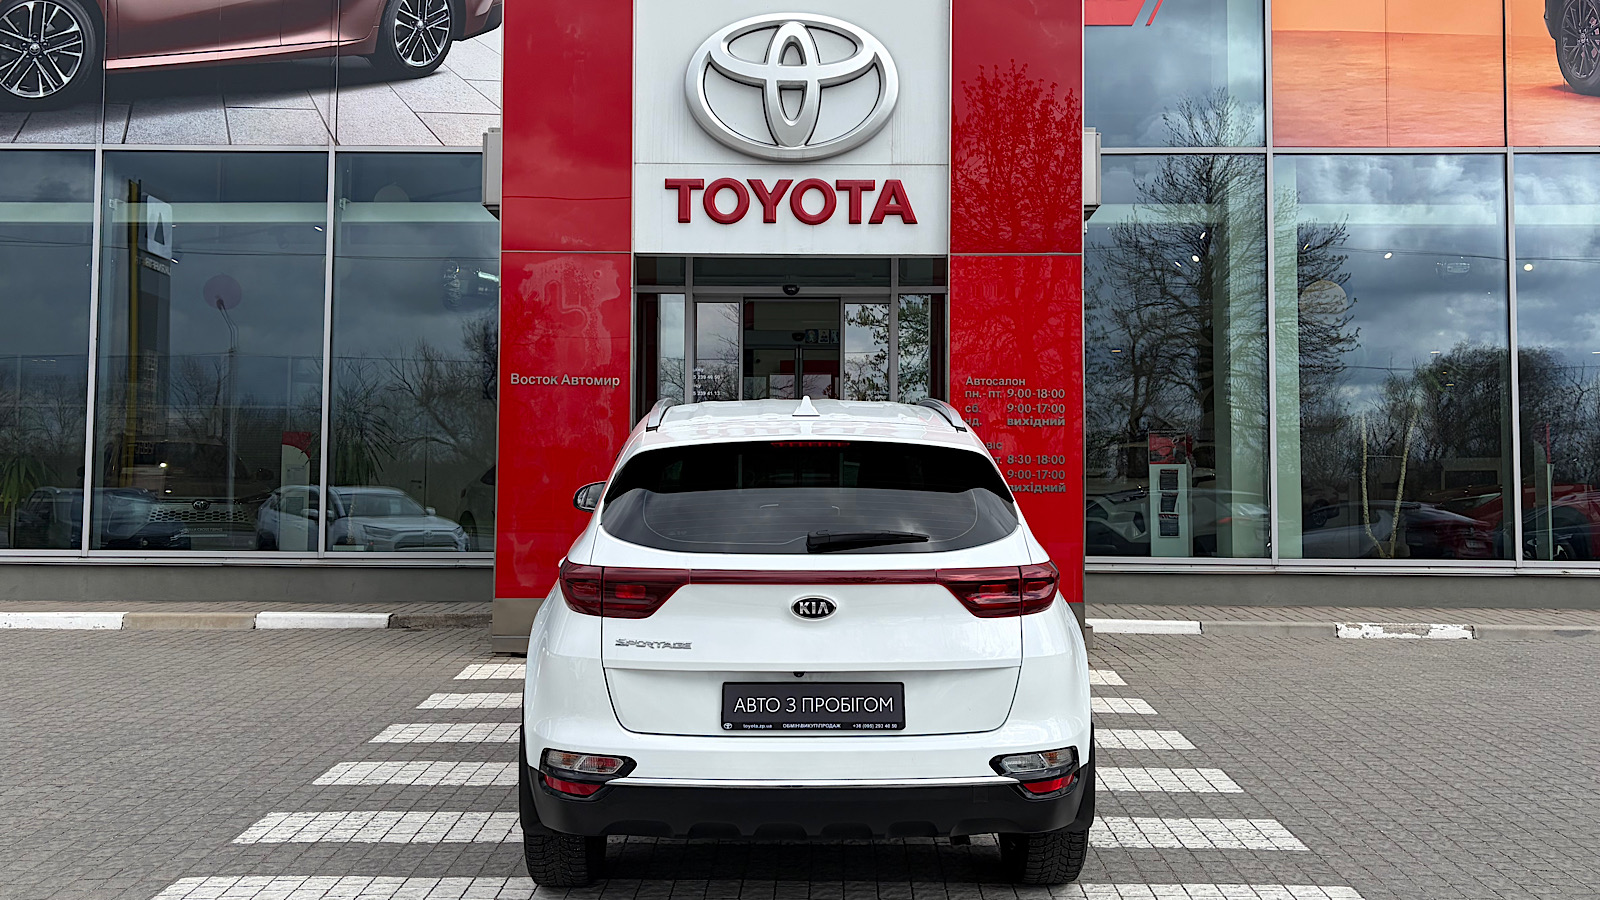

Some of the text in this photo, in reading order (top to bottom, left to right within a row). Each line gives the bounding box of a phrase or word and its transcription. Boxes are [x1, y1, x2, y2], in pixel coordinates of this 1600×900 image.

[665, 178, 918, 225] TOYOTA
[510, 373, 620, 388] Восток Автомир
[965, 376, 1026, 386] Автосалон
[1007, 389, 1066, 399] 9:00-18:00
[965, 403, 1066, 414] сб. 9:00-17:00
[1007, 416, 1066, 428] вихідний
[1007, 455, 1066, 465] 8:30-18:00
[1007, 469, 1066, 480] 9:00-17:00
[799, 601, 830, 615] KIA
[615, 638, 692, 650] SPORTAGE
[733, 697, 894, 713] АВТО З ПРОБІГОМ
